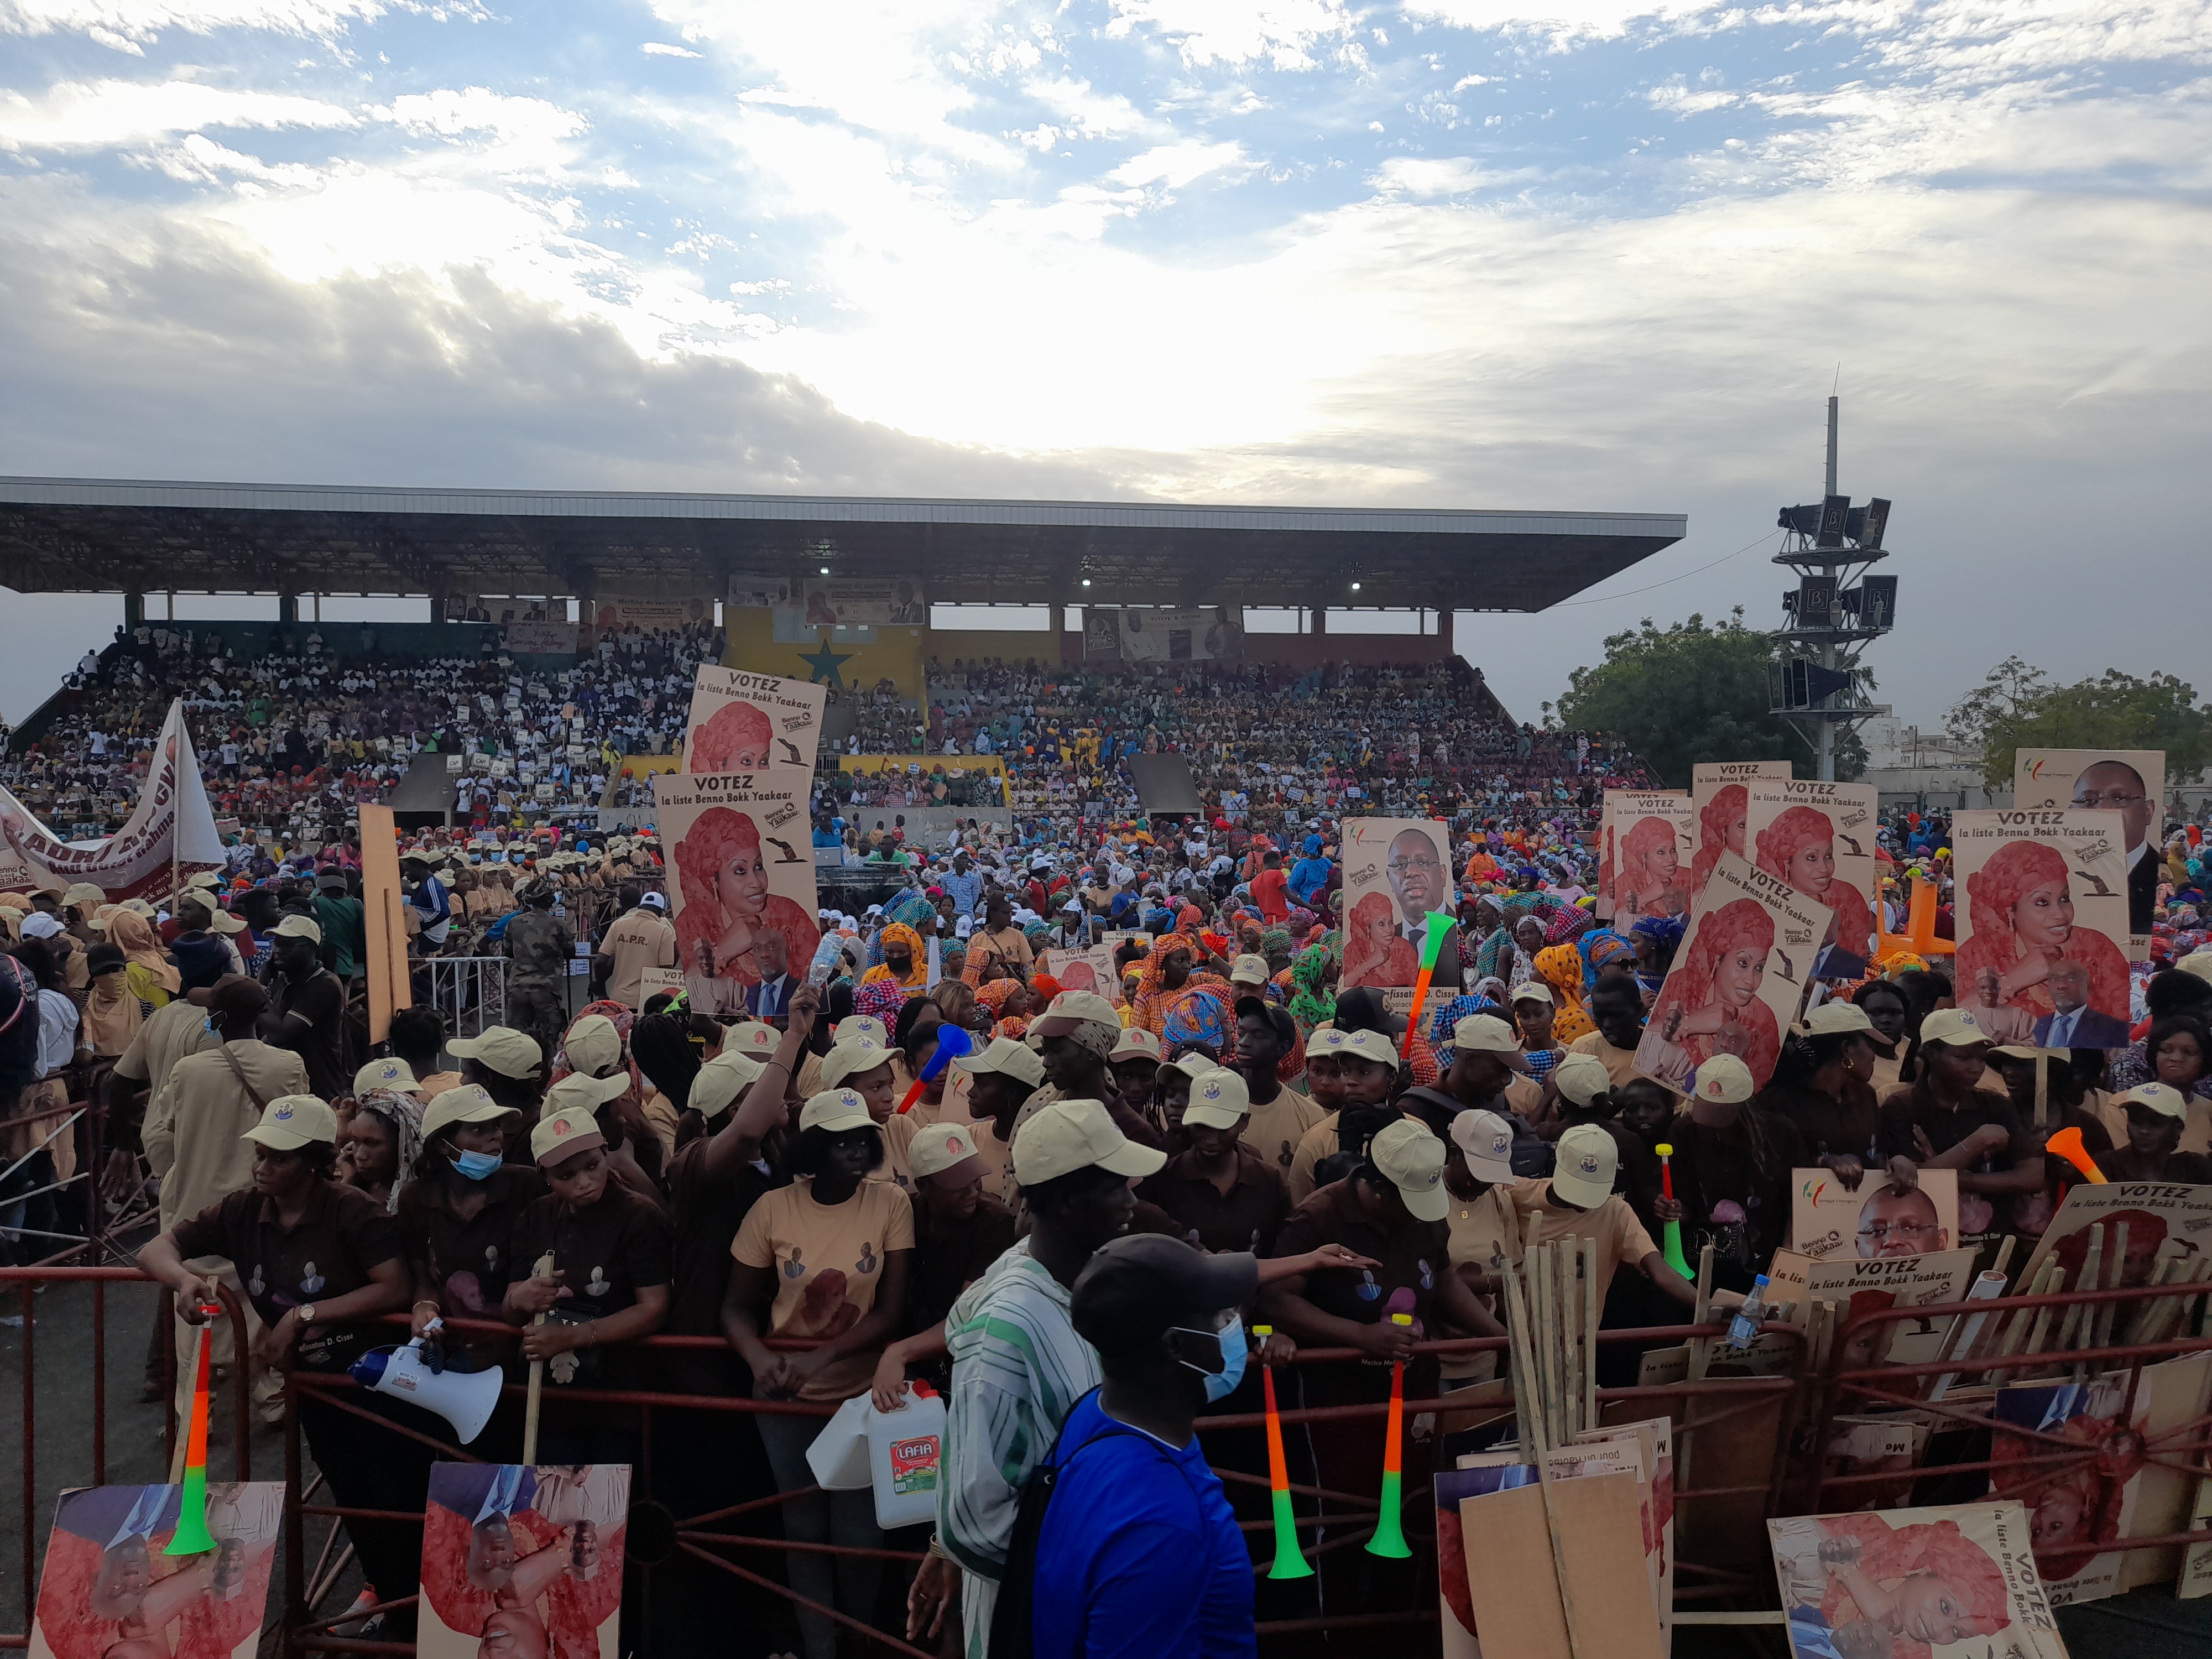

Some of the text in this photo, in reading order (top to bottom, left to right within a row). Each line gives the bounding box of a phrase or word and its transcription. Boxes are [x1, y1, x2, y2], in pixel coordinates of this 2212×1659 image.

[729, 672, 782, 692] VOTEZ
[697, 681, 812, 710] la liste Benno Bokk Yaakaar
[1720, 764, 1760, 774] VOTEZ
[693, 775, 754, 791] VOTEZ
[1784, 781, 1837, 795] VOTEZ
[661, 790, 792, 806] la liste Benno Bokk Yaakaar
[1638, 799, 1675, 808] VOTEZ
[1753, 792, 1866, 807] la liste Benno Bokk Yaakaar
[764, 807, 784, 820] Benno
[767, 810, 800, 827] Yaakaar
[1996, 811, 2065, 825] VOTEZ
[1959, 827, 2106, 838] la liste Benno Bokk Yaakaar
[2075, 844, 2097, 854] Benno
[2077, 847, 2113, 862] Yaakaar
[1349, 868, 1367, 879] Benno
[1352, 872, 1379, 886] Yaakaar
[1749, 866, 1795, 902] VOTEZ
[1717, 866, 1816, 928] la liste Benno Bokk Yaakaar
[617, 933, 648, 946] A.P.R.
[1786, 934, 1813, 943] Yaakaar
[1436, 989, 1455, 998] Cissé
[2120, 1185, 2193, 1198] VOTEZ
[2084, 1199, 2107, 1208] liste
[2147, 1199, 2176, 1208] Bokk
[1801, 1237, 1827, 1250] Benno
[1804, 1240, 1844, 1257] Yaakaar
[1855, 1258, 1922, 1275] VOTEZ
[1775, 1269, 1786, 1280] la
[1809, 1271, 1953, 1290] la liste Benno Bokk Yaakaar
[1660, 1361, 1683, 1369] liste
[899, 1443, 932, 1459] LAFIA
[1600, 1449, 1620, 1460] pour
[1994, 1509, 2032, 1624] la liste Benno Bokk
[2015, 1551, 2053, 1630] VOTEZ
